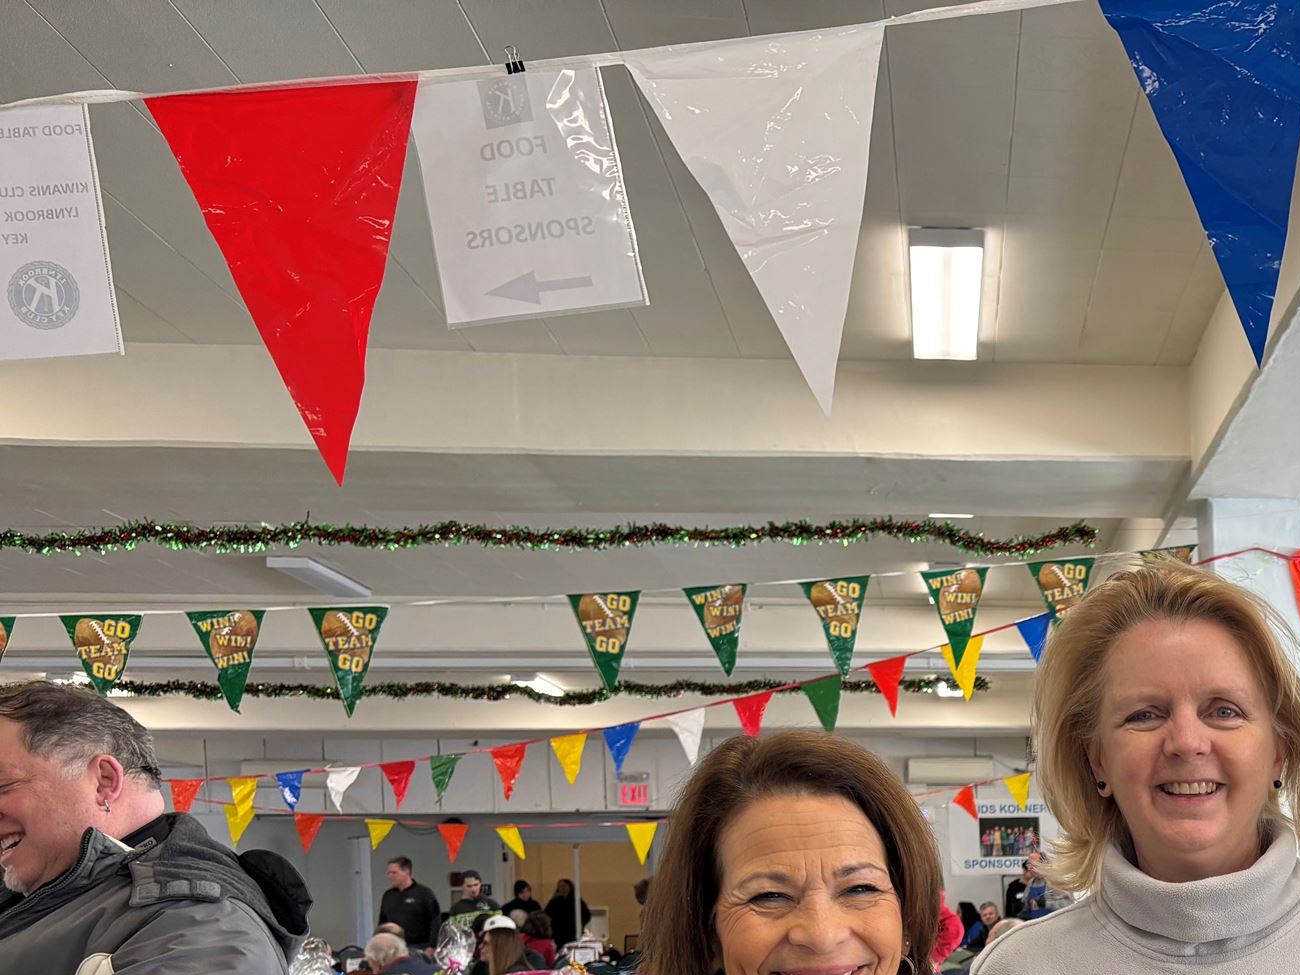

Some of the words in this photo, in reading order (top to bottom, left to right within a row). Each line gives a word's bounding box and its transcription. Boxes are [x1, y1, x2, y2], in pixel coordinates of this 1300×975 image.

[1063, 563, 1087, 580] GO
[837, 581, 861, 598] GO
[944, 591, 977, 605] WIN!
[1044, 582, 1085, 602] TEAM
[606, 594, 632, 612] GO
[816, 602, 860, 618] TEAM
[351, 611, 378, 630] GO
[582, 615, 630, 633] TEAM
[942, 608, 974, 625] WIN!
[103, 619, 131, 639] GO
[829, 621, 853, 638] GO
[216, 634, 251, 648] WIN!
[325, 634, 373, 650] TEAM
[595, 636, 621, 654] GO
[77, 643, 127, 660] TEAM
[215, 651, 250, 669] WIN!
[92, 662, 118, 681] GO
[337, 654, 365, 673] GO
[621, 783, 649, 805] EXIT
[978, 804, 997, 815] IDS
